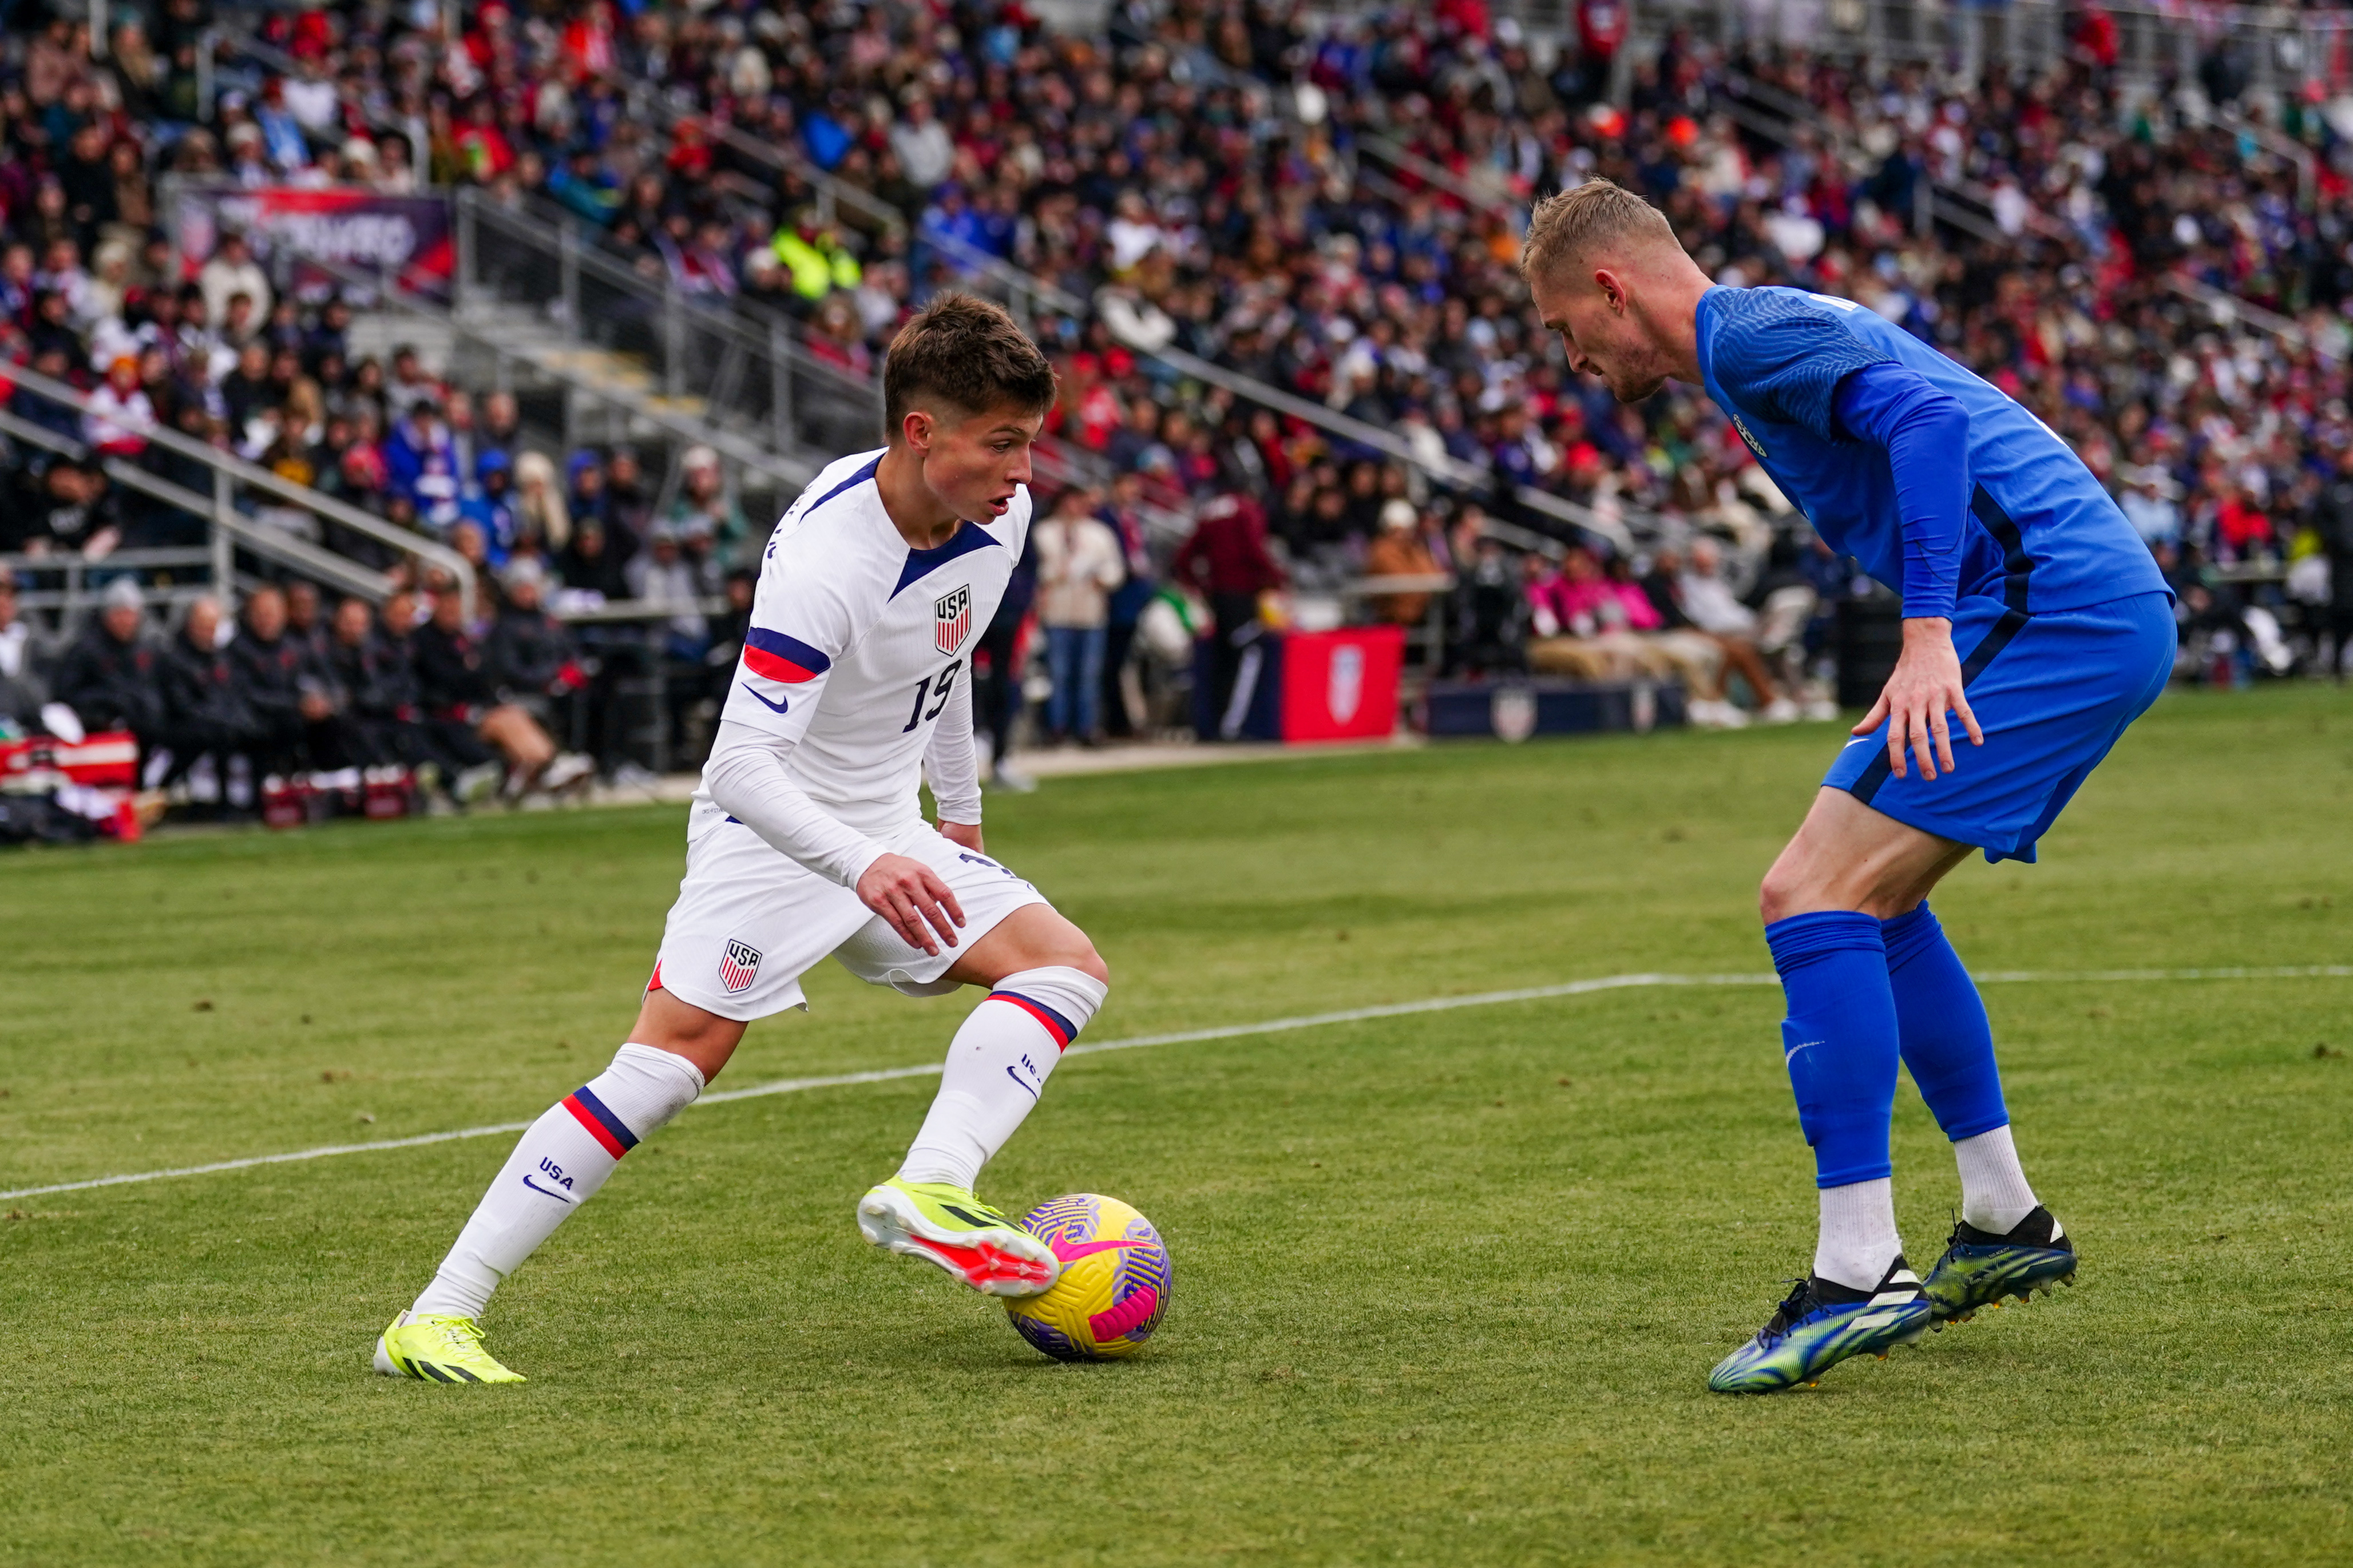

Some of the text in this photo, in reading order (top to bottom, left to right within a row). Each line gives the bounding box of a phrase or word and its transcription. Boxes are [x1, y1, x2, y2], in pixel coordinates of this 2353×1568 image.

[937, 589, 967, 620] USA
[902, 658, 962, 733] 19
[729, 943, 759, 966] USA
[539, 1156, 574, 1191] USA
